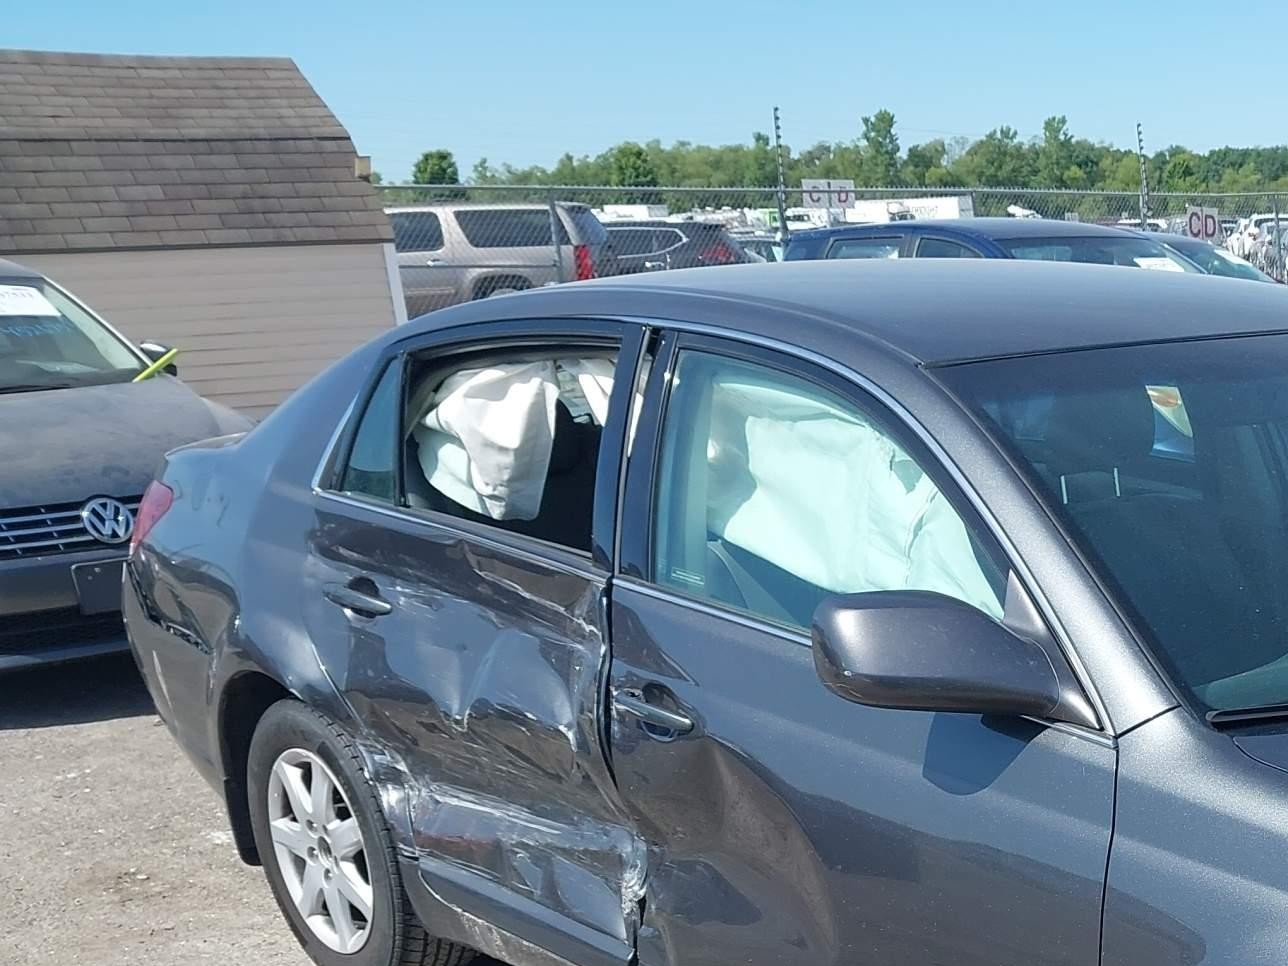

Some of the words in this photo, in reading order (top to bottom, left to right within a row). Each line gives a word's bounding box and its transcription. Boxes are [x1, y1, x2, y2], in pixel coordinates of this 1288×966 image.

[809, 185, 821, 203] C
[838, 185, 848, 203] D
[1189, 211, 1201, 238] C
[1205, 214, 1216, 237] D
